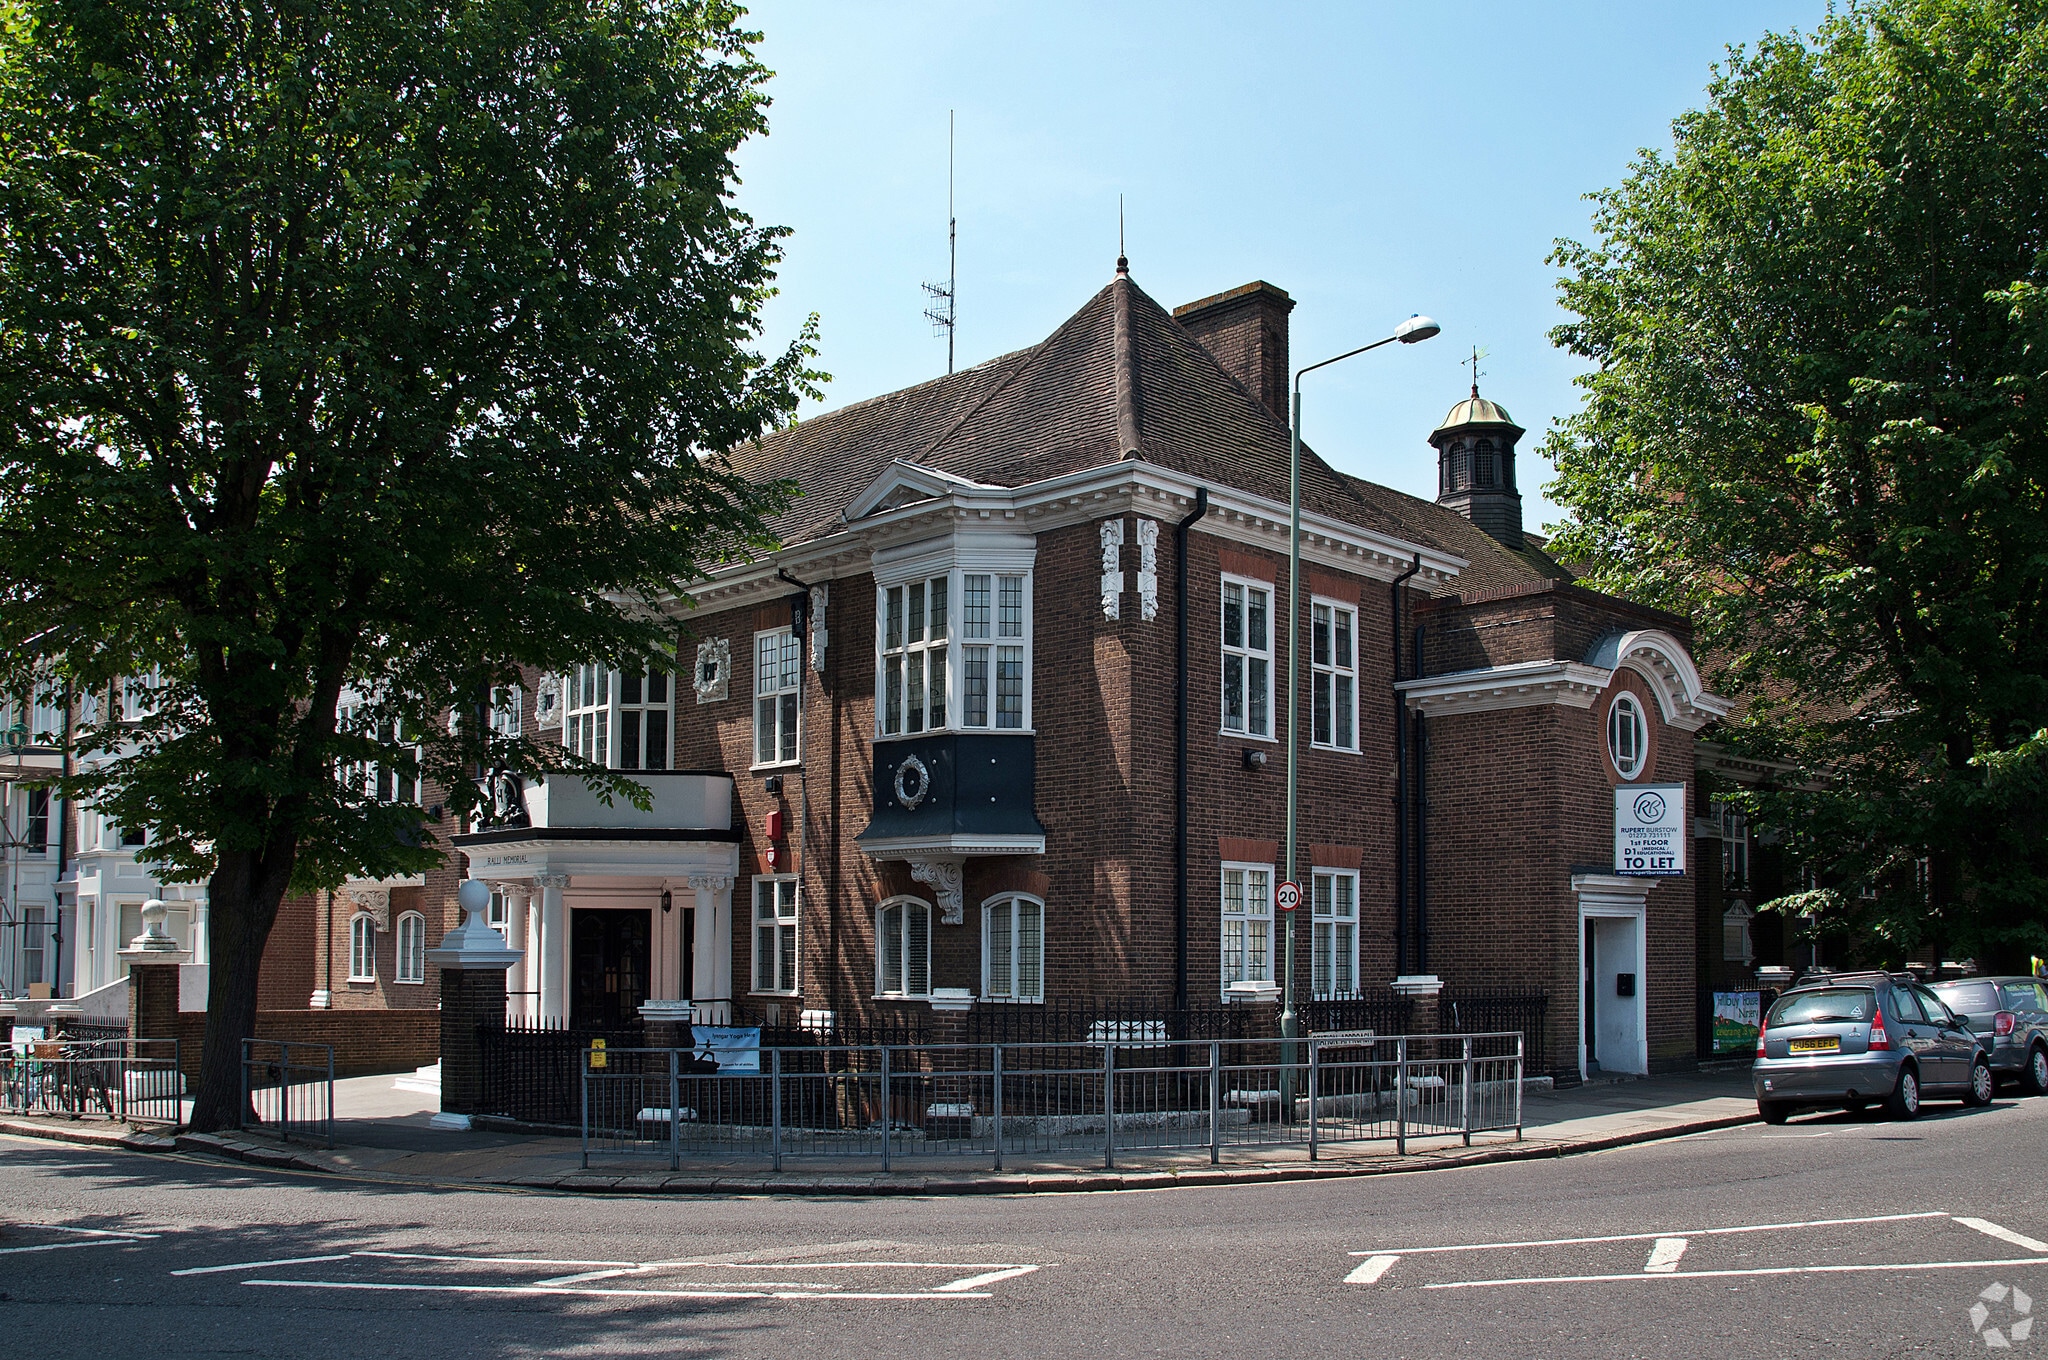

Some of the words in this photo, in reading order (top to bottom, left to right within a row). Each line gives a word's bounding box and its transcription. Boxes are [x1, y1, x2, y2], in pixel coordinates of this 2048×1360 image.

[487, 856, 502, 865] RALLI
[503, 854, 528, 864] MEMORIAL
[1624, 857, 1645, 869] TO
[1650, 857, 1675, 869] LET
[1279, 891, 1297, 903] 20
[1793, 1040, 1816, 1050] GU56
